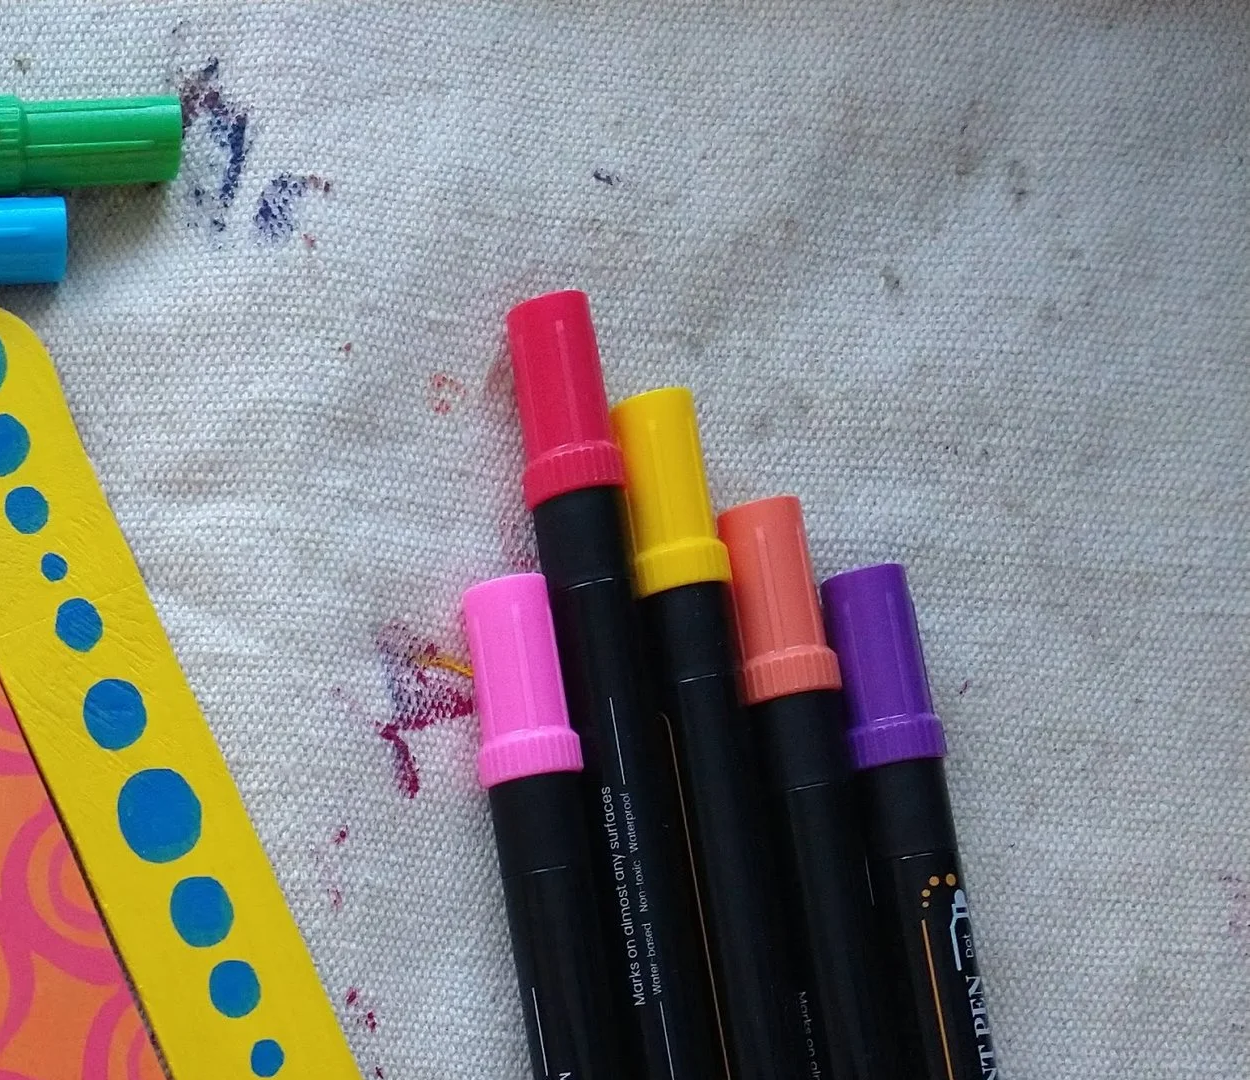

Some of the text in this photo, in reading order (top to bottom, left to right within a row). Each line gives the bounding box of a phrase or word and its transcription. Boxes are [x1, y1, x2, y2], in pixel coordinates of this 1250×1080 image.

[600, 786, 645, 1006] Marks on almost any surfaces
[620, 792, 662, 995] Water-based Non-toxic Waterproof
[962, 933, 974, 959] Dot
[965, 975, 990, 1038] PEN
